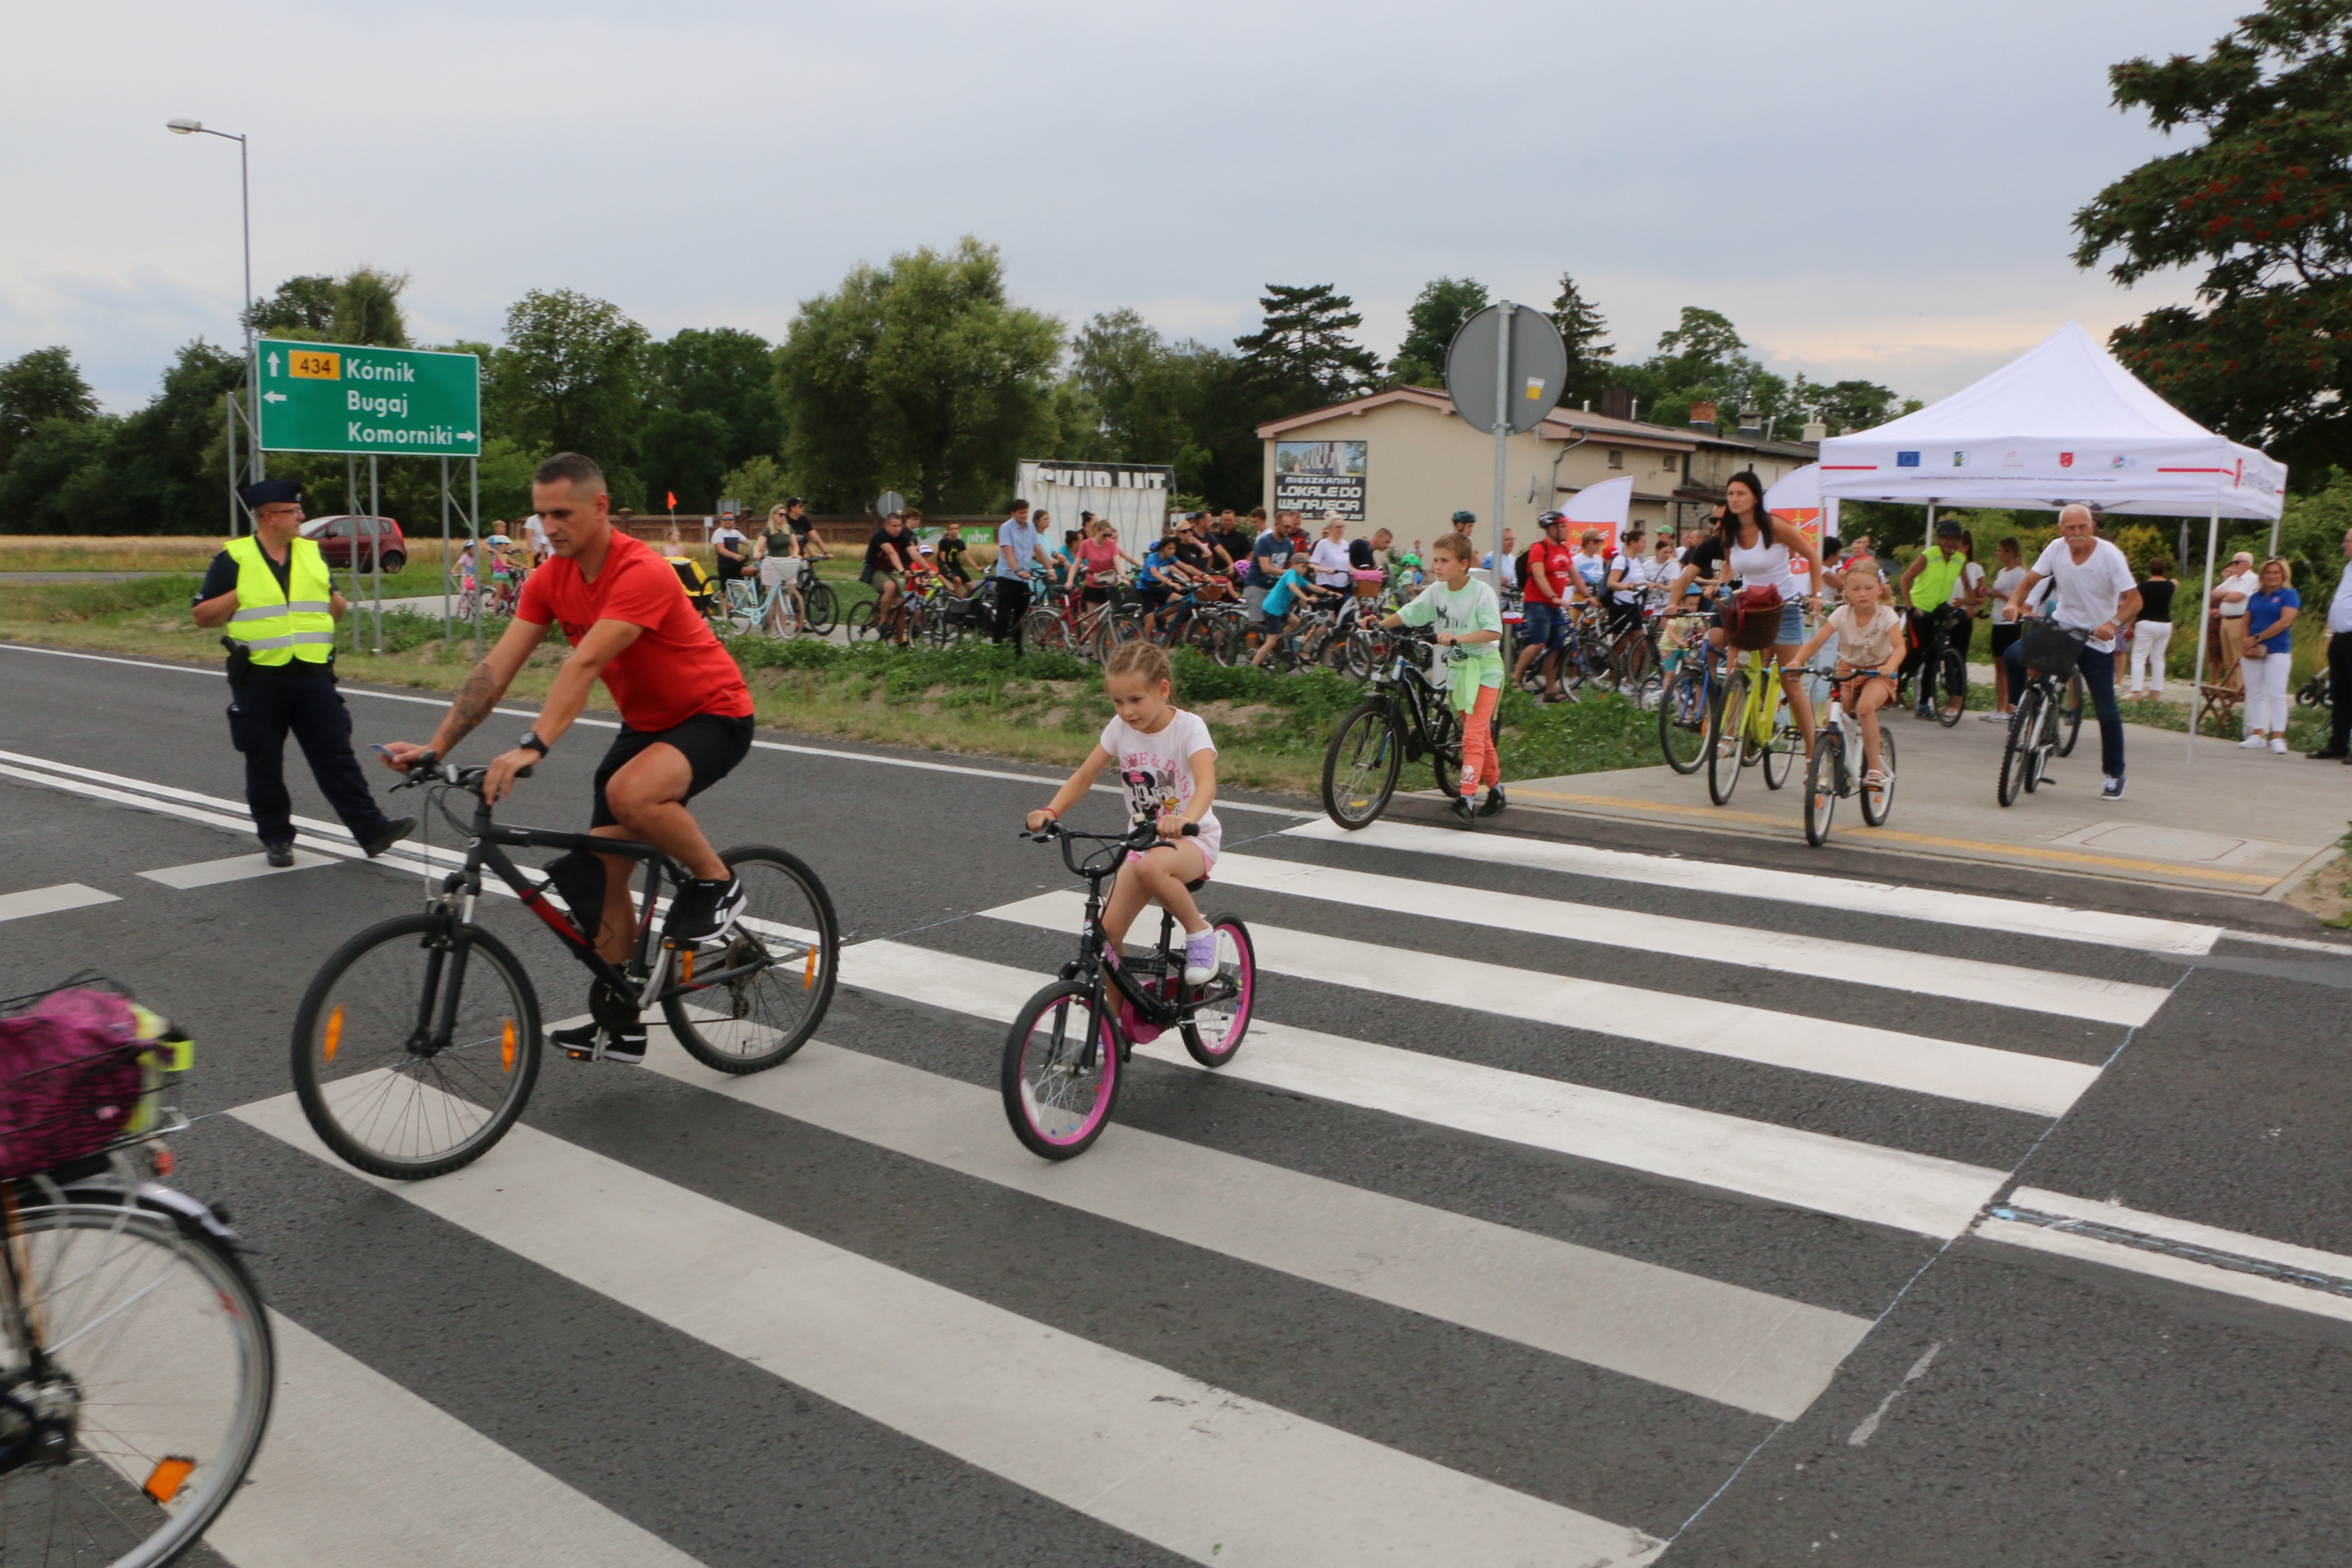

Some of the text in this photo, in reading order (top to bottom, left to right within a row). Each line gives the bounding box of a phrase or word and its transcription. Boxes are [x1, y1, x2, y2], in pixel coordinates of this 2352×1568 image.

[299, 357, 415, 382] 434 Kórnik
[347, 389, 408, 418] Bugaj
[348, 421, 453, 445] Komorniki
[1277, 485, 1362, 498] LOKALE DO
[1285, 476, 1351, 485] MIESZKANIA
[1151, 754, 1161, 768] &
[1163, 759, 1192, 799] DAISY
